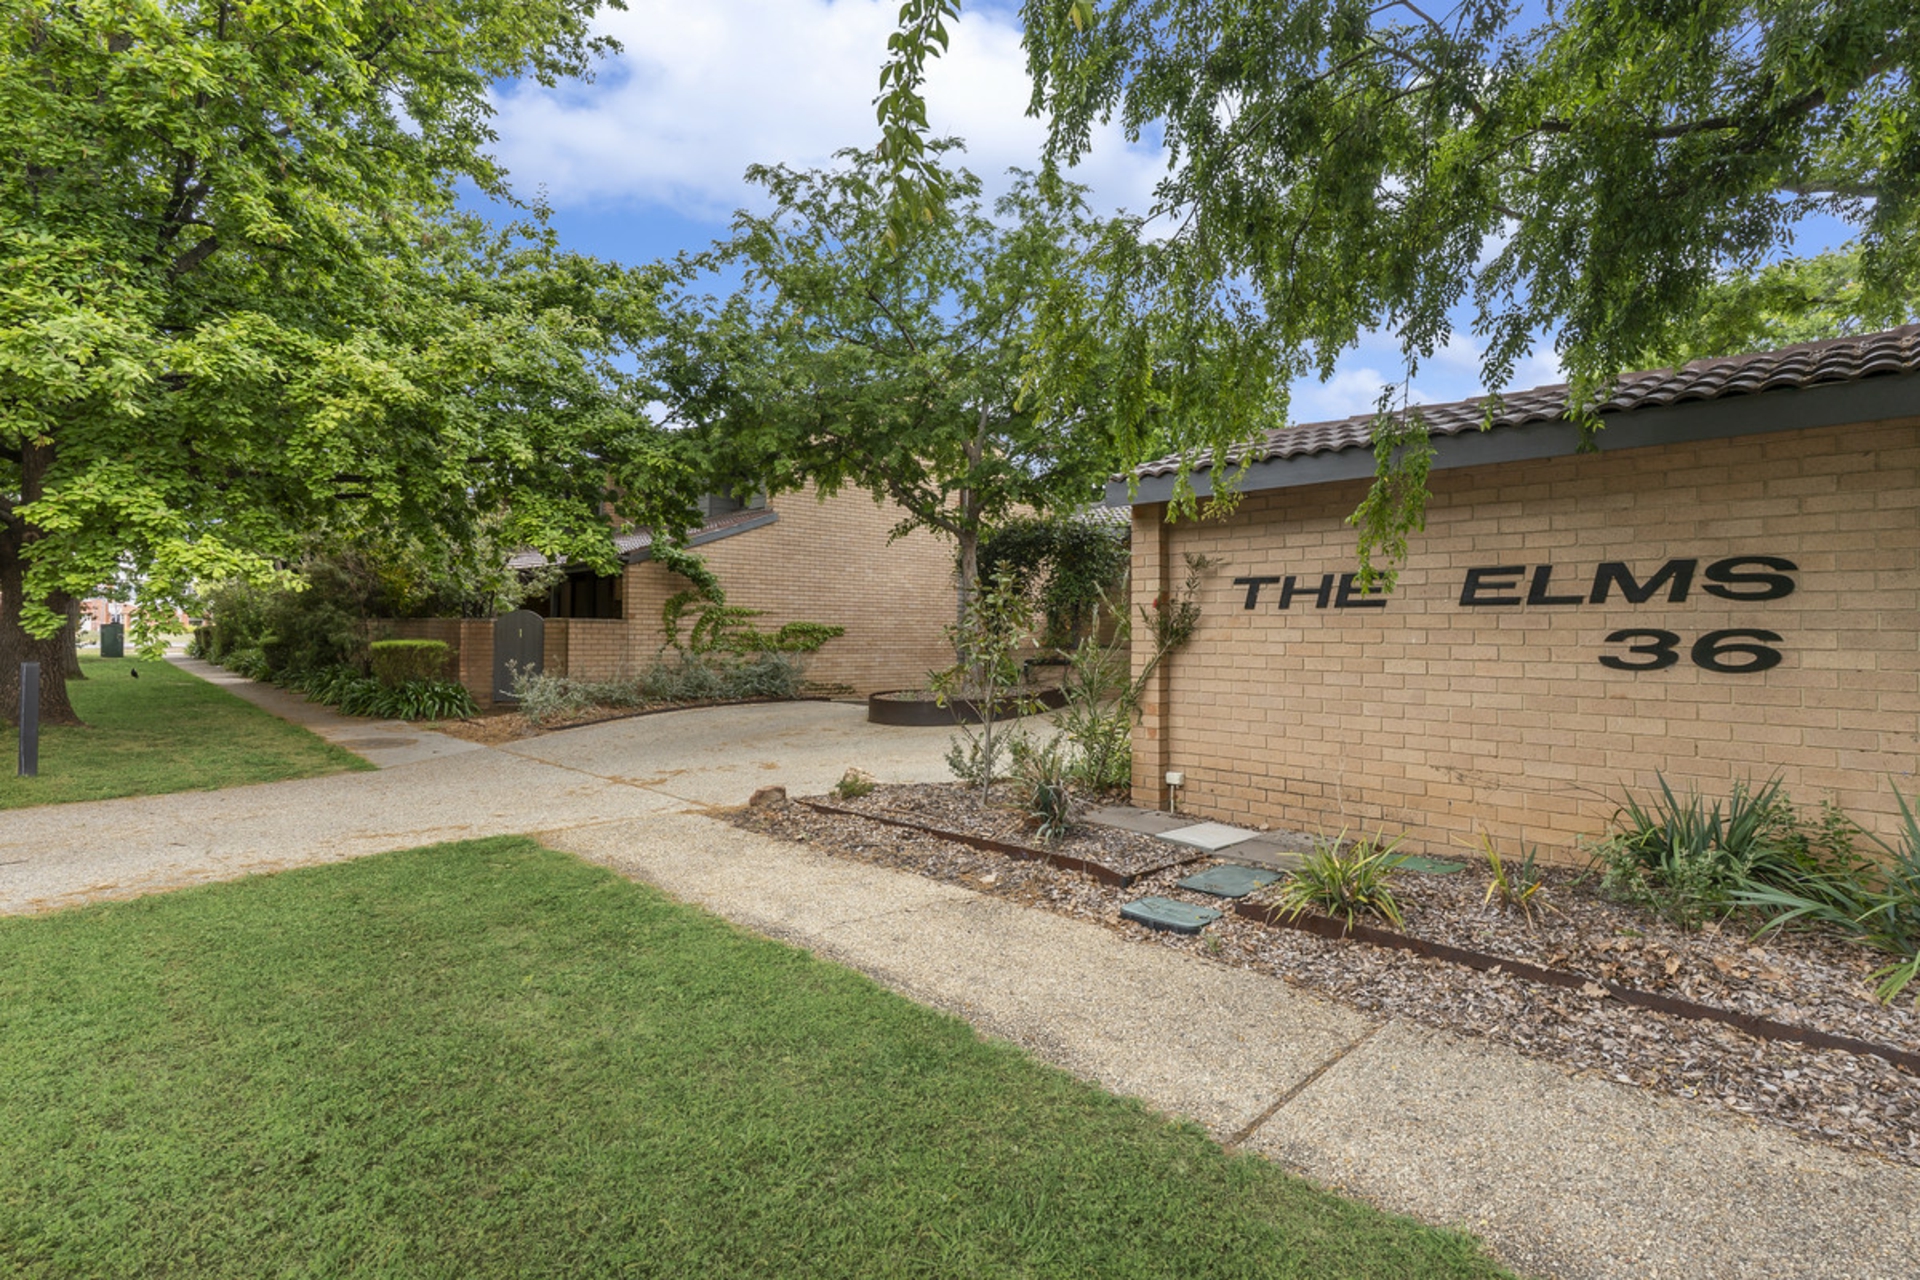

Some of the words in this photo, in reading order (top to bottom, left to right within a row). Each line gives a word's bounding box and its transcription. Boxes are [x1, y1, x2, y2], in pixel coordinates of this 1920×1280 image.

[1233, 572, 1388, 610] THE
[1459, 556, 1799, 607] ELMS
[1599, 628, 1784, 674] 36
